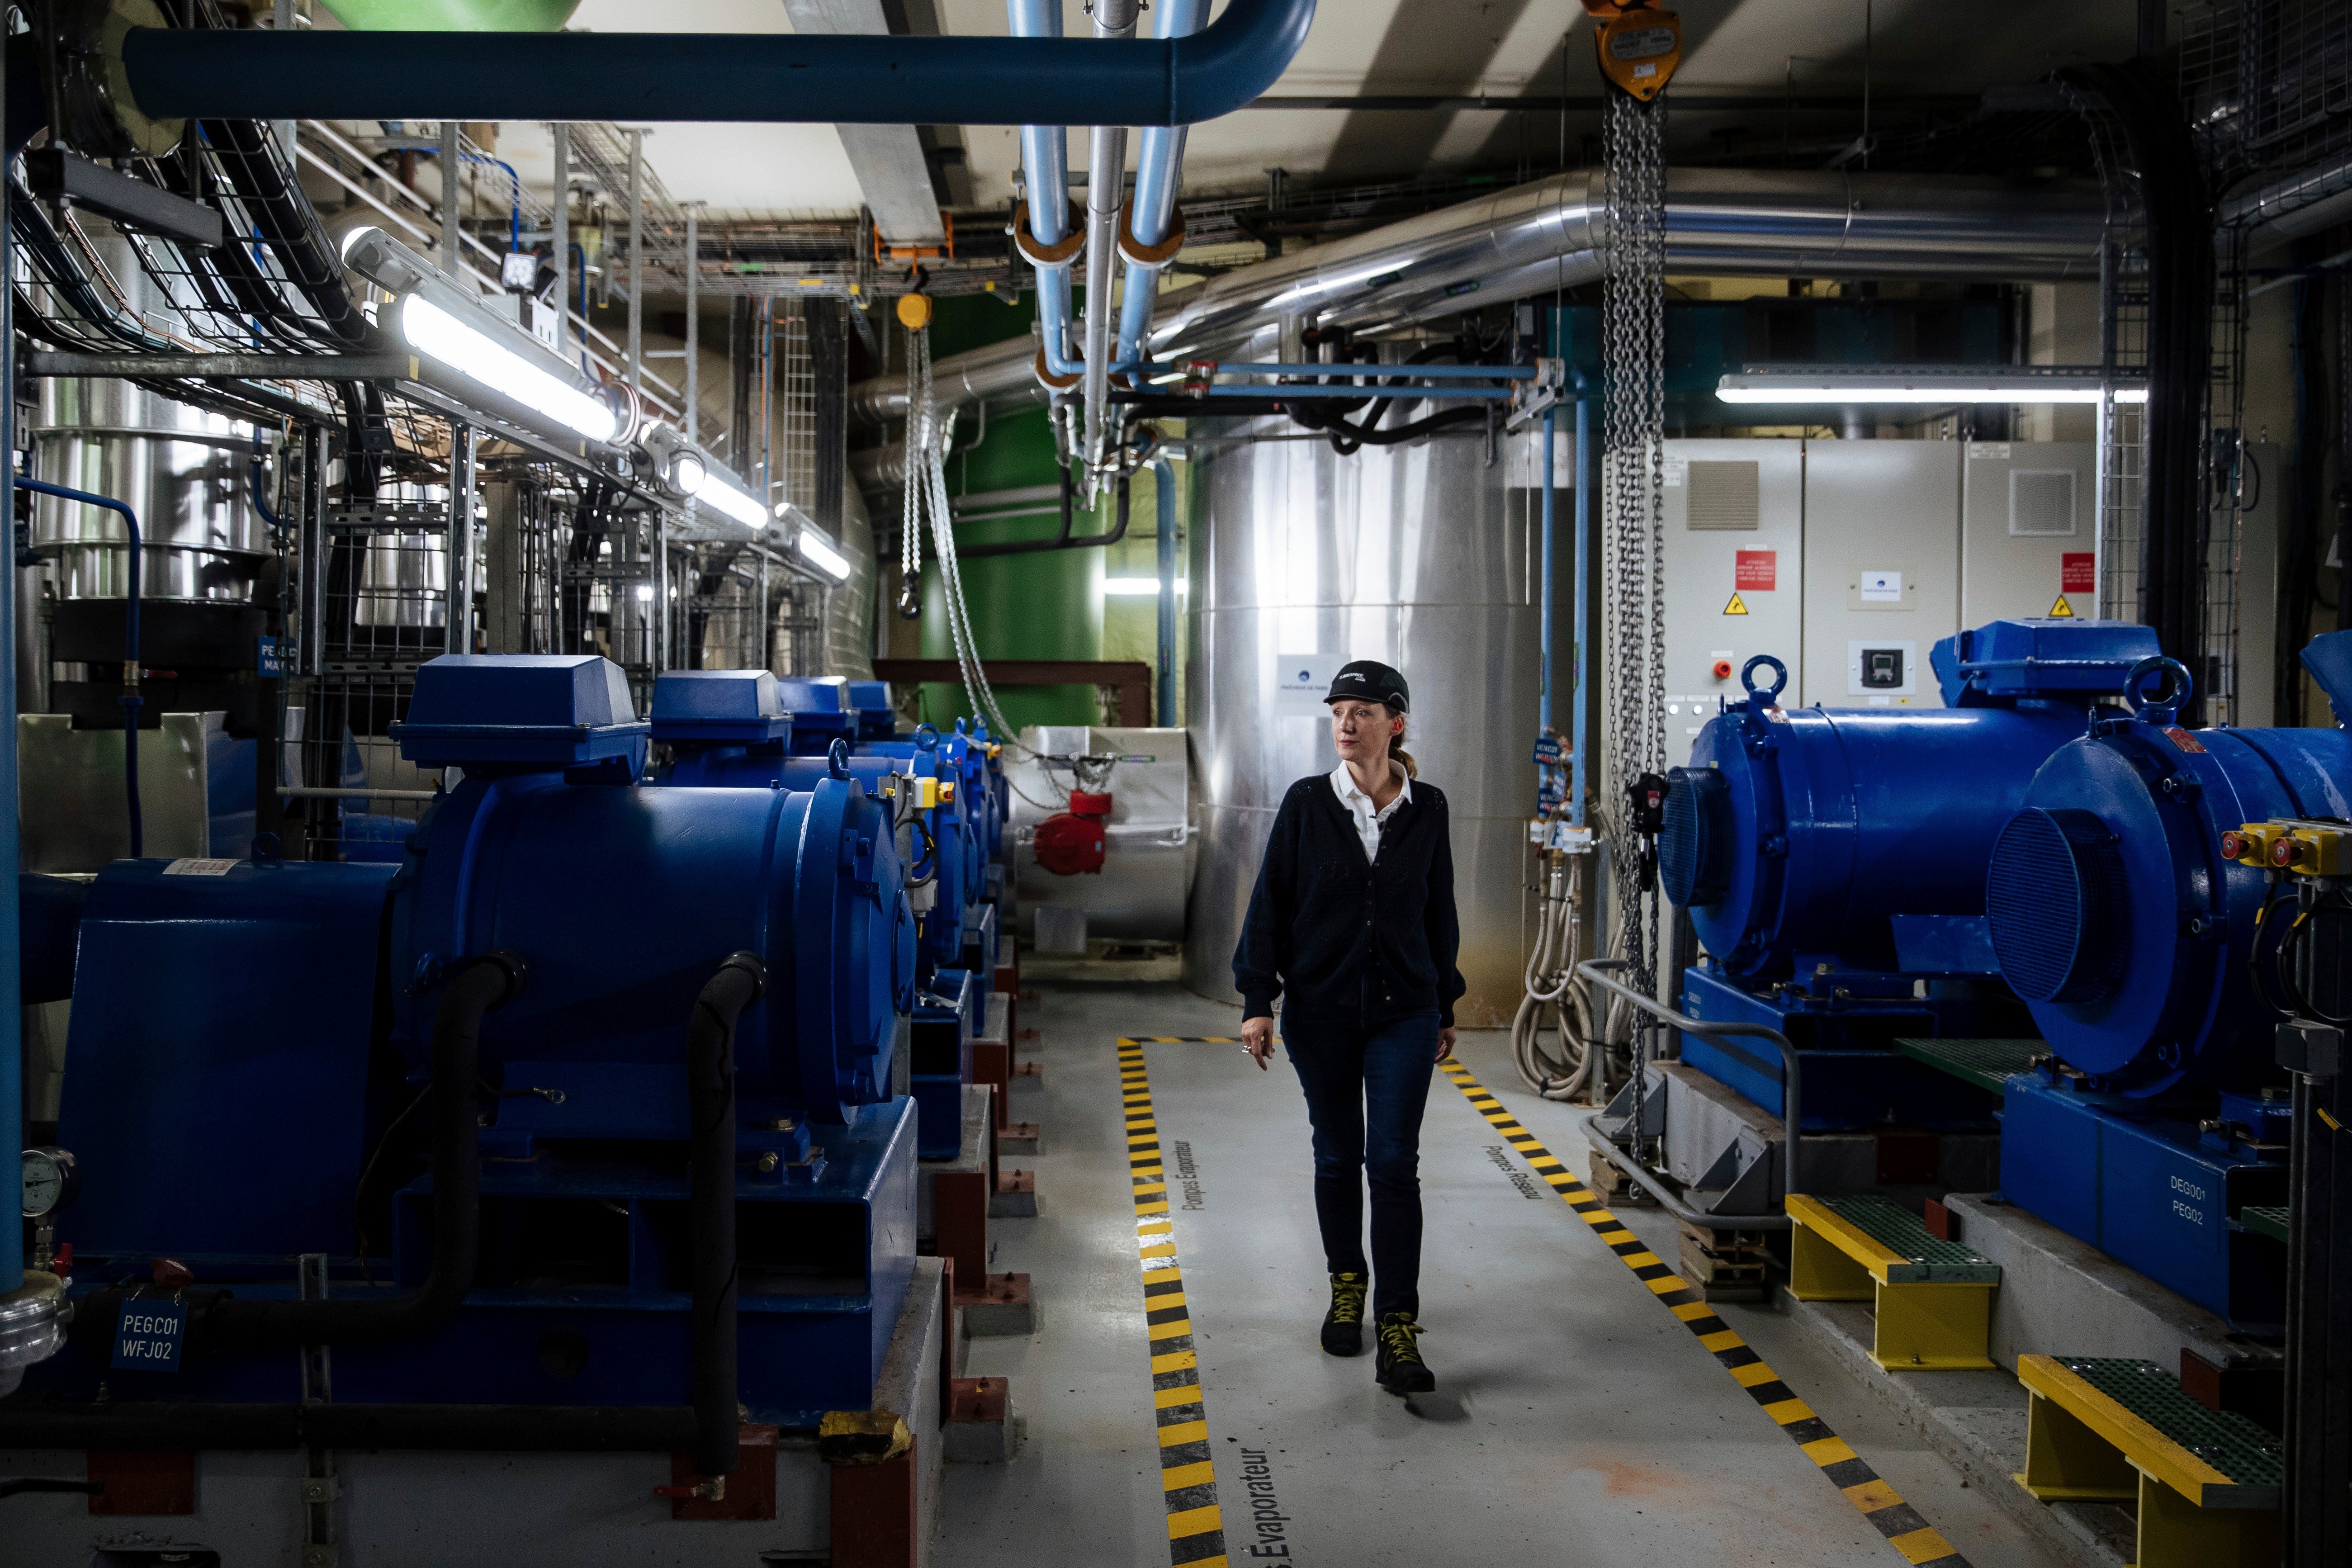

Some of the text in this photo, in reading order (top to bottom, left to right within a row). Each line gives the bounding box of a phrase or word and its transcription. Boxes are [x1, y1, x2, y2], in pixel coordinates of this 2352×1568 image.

[1481, 1146, 1543, 1199] Pompes Réseau
[1181, 1180, 1207, 1210] Pompes
[2171, 1175, 2205, 1202] DEG001
[2173, 1200, 2203, 1226] PEG02
[123, 1315, 178, 1335] PEGC01
[123, 1339, 172, 1359] WFJ02
